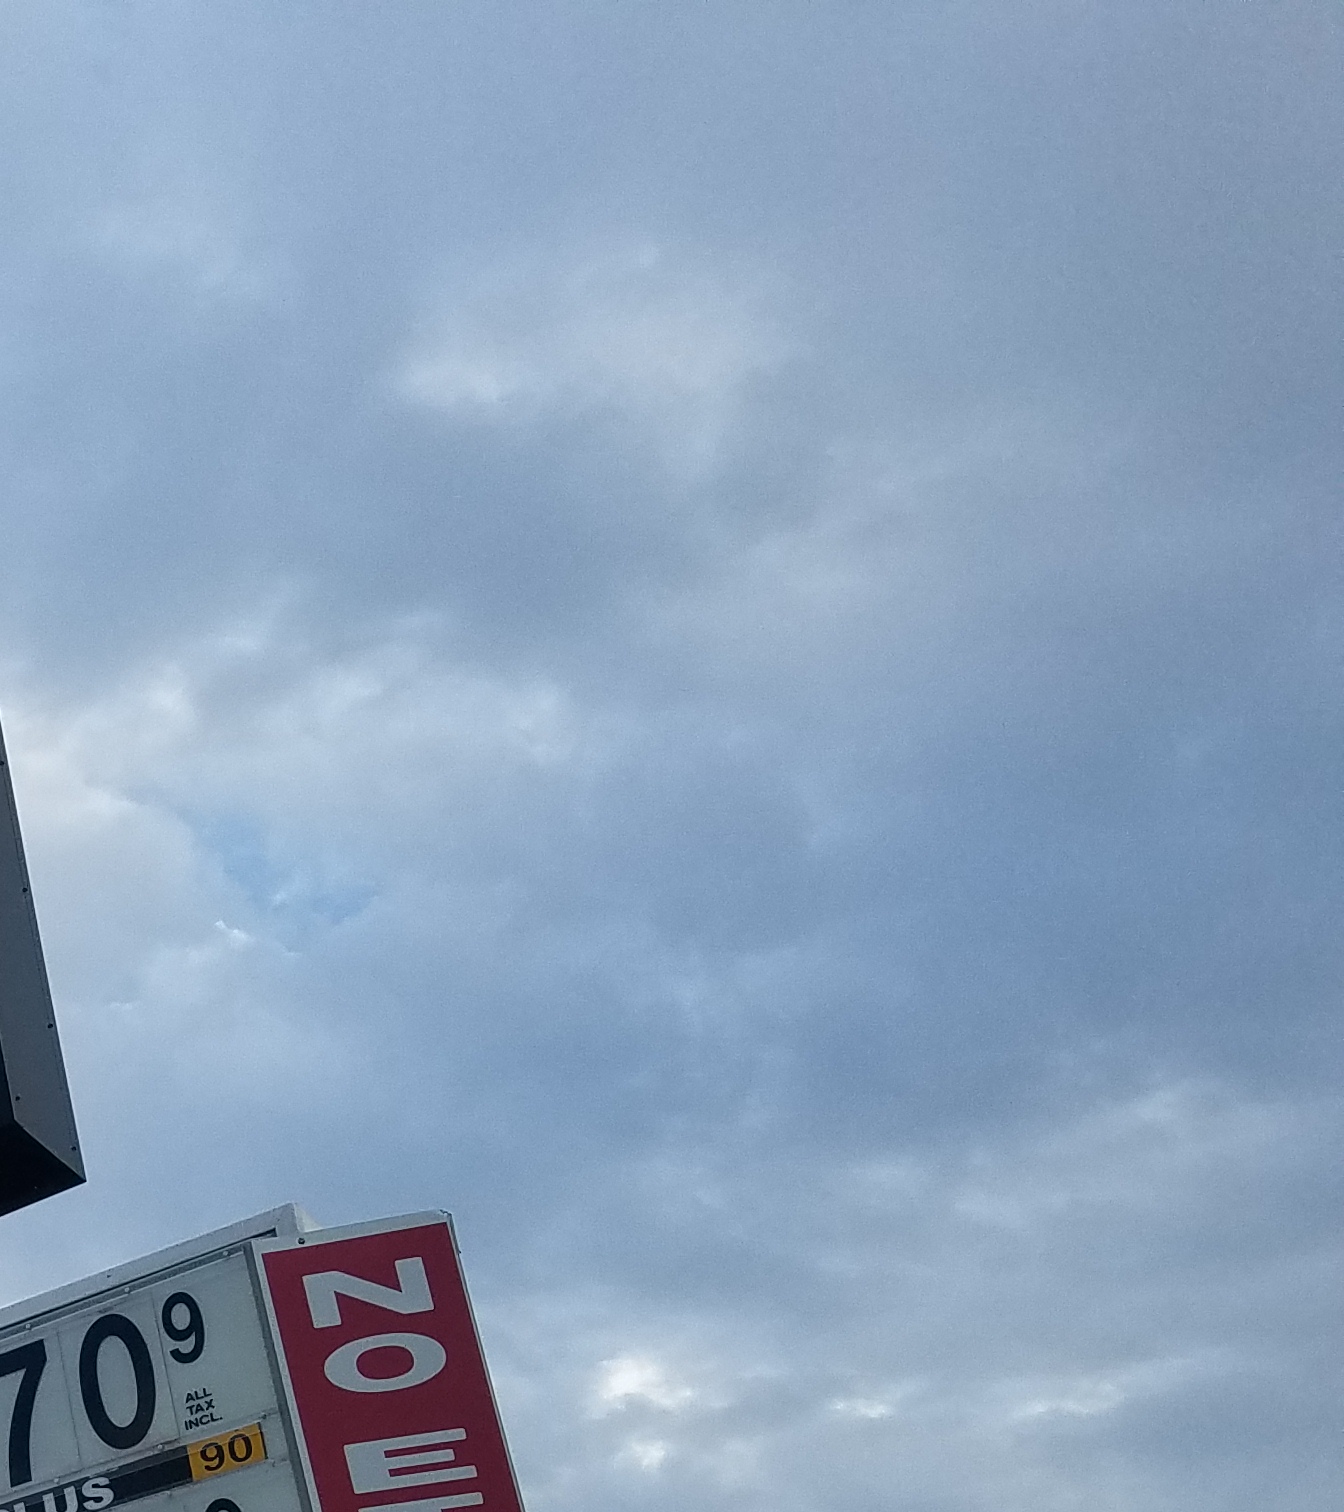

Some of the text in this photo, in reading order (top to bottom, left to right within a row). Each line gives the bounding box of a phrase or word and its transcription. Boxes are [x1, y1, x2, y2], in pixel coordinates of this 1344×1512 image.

[303, 1256, 447, 1393] NO
[185, 1387, 213, 1404] ALL
[186, 1398, 216, 1416] TAX
[184, 1412, 224, 1431] INCL.
[199, 1433, 253, 1472] 90
